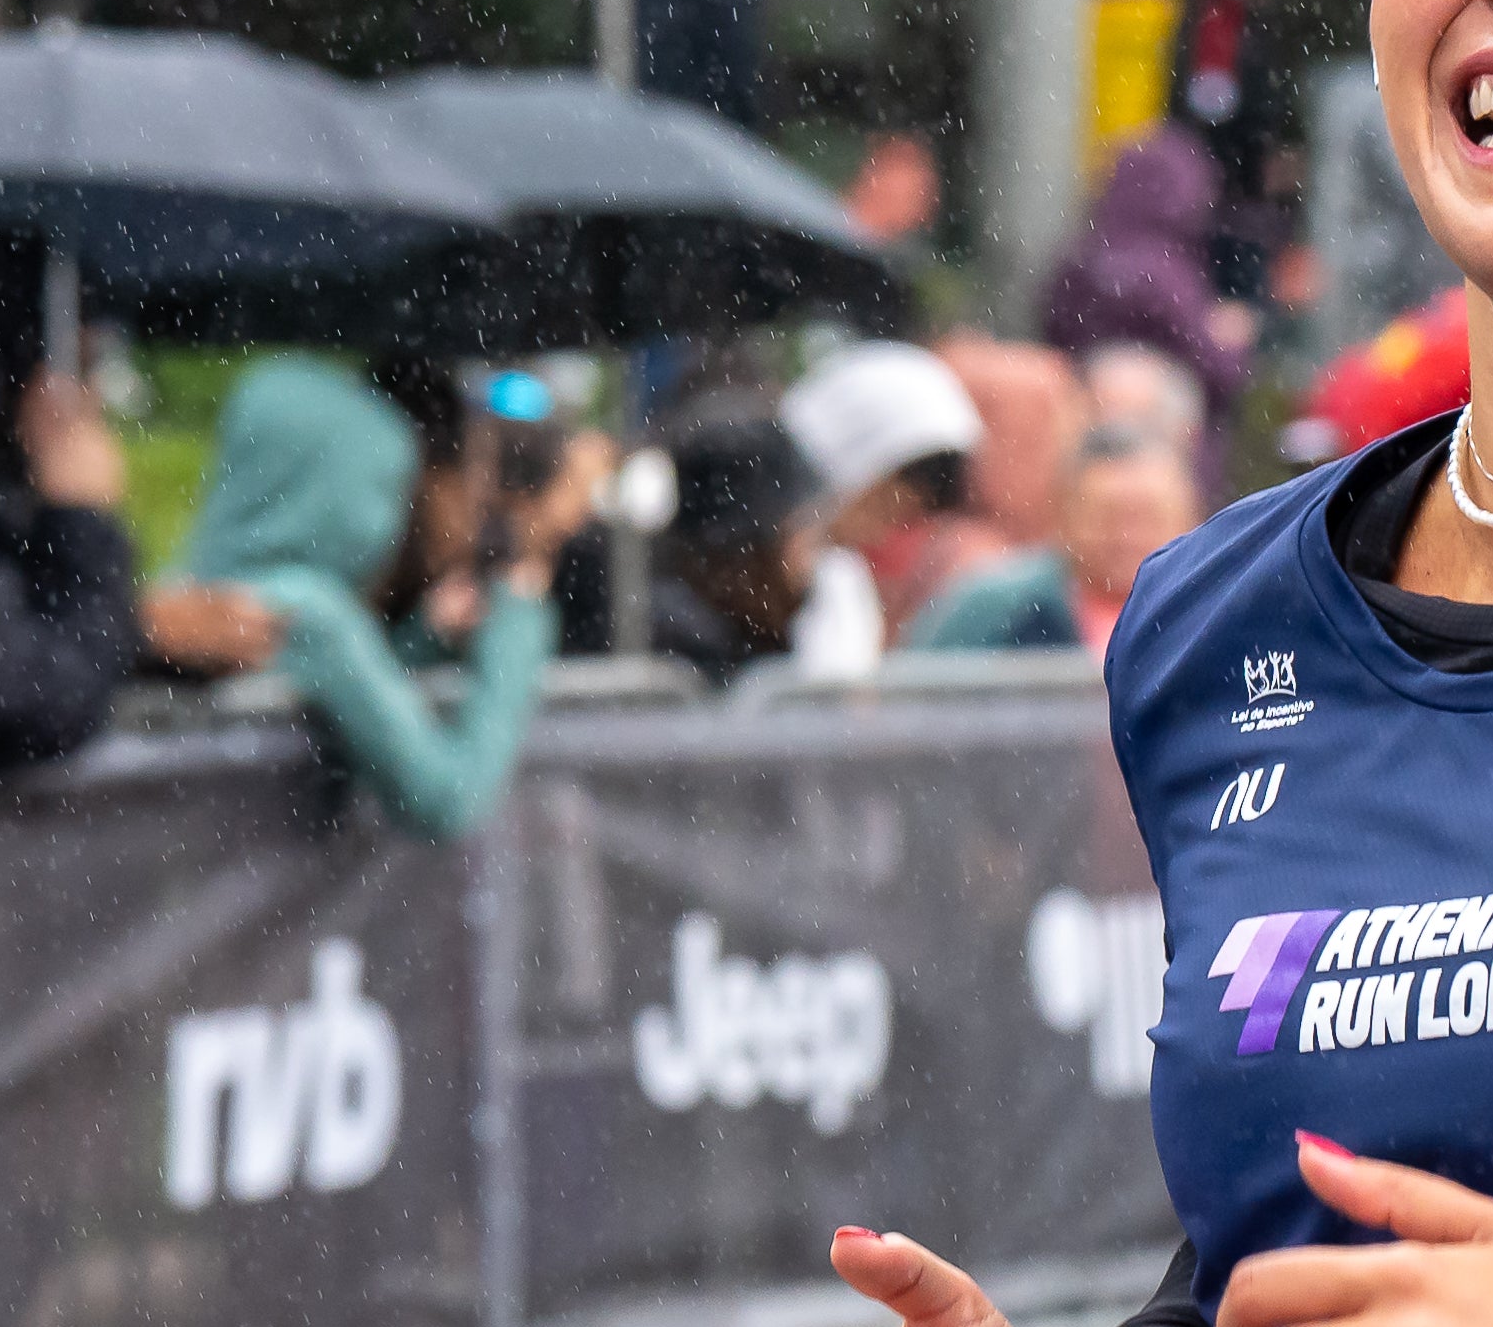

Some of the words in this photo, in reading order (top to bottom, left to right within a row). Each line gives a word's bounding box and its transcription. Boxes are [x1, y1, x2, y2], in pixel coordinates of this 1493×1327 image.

[164, 937, 402, 1209] rvb
[635, 913, 892, 1135] Jeep
[1298, 971, 1415, 1053] RUN
